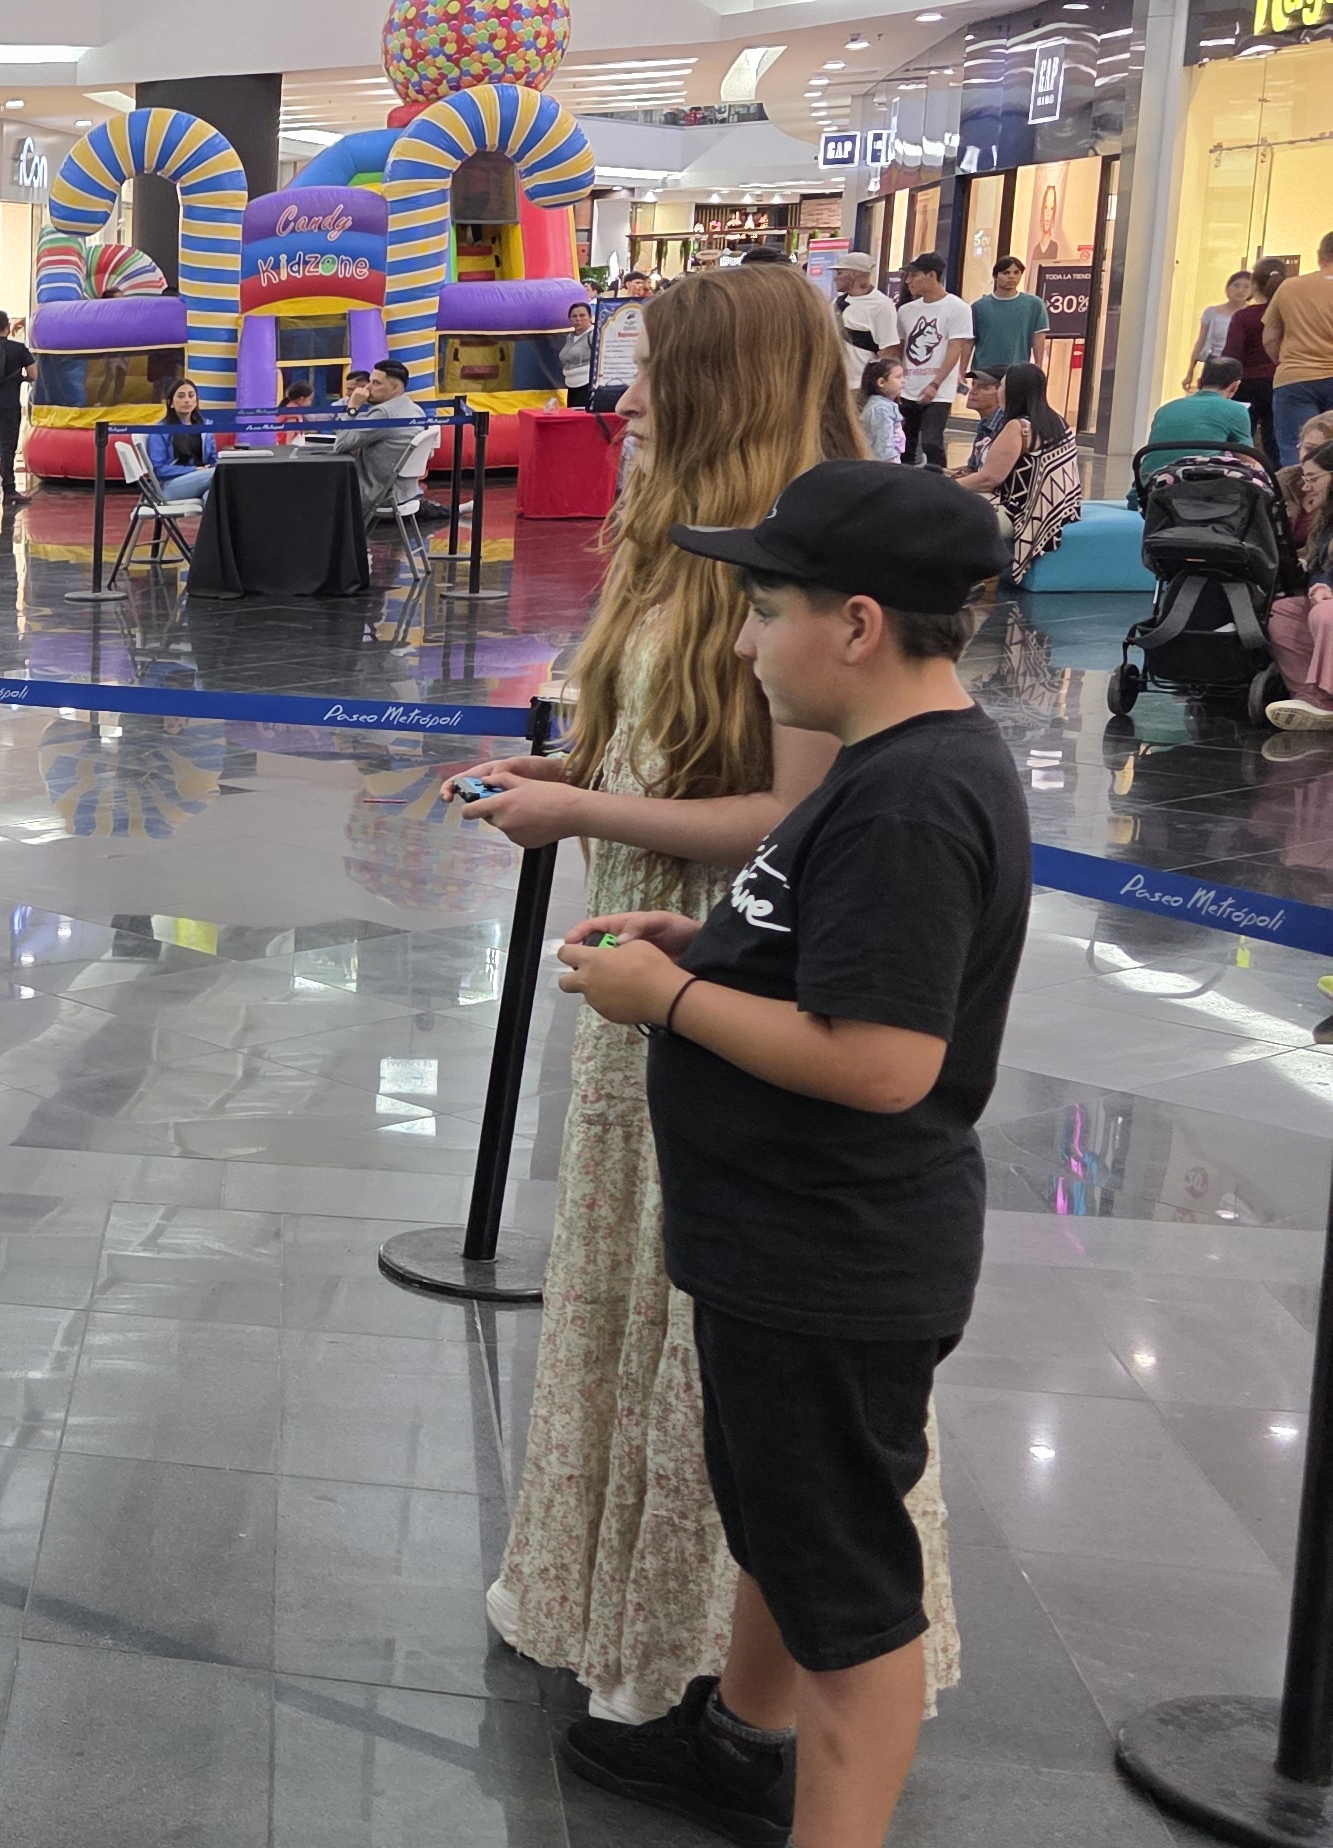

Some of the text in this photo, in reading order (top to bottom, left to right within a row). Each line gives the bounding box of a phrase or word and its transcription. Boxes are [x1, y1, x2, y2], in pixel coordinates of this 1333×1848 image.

[826, 140, 853, 159] GAP
[276, 203, 353, 241] Candy
[257, 251, 370, 287] Kidzone
[323, 704, 464, 729] Paseo Metrópoli
[1119, 873, 1286, 931] Paseo Metrópoli
